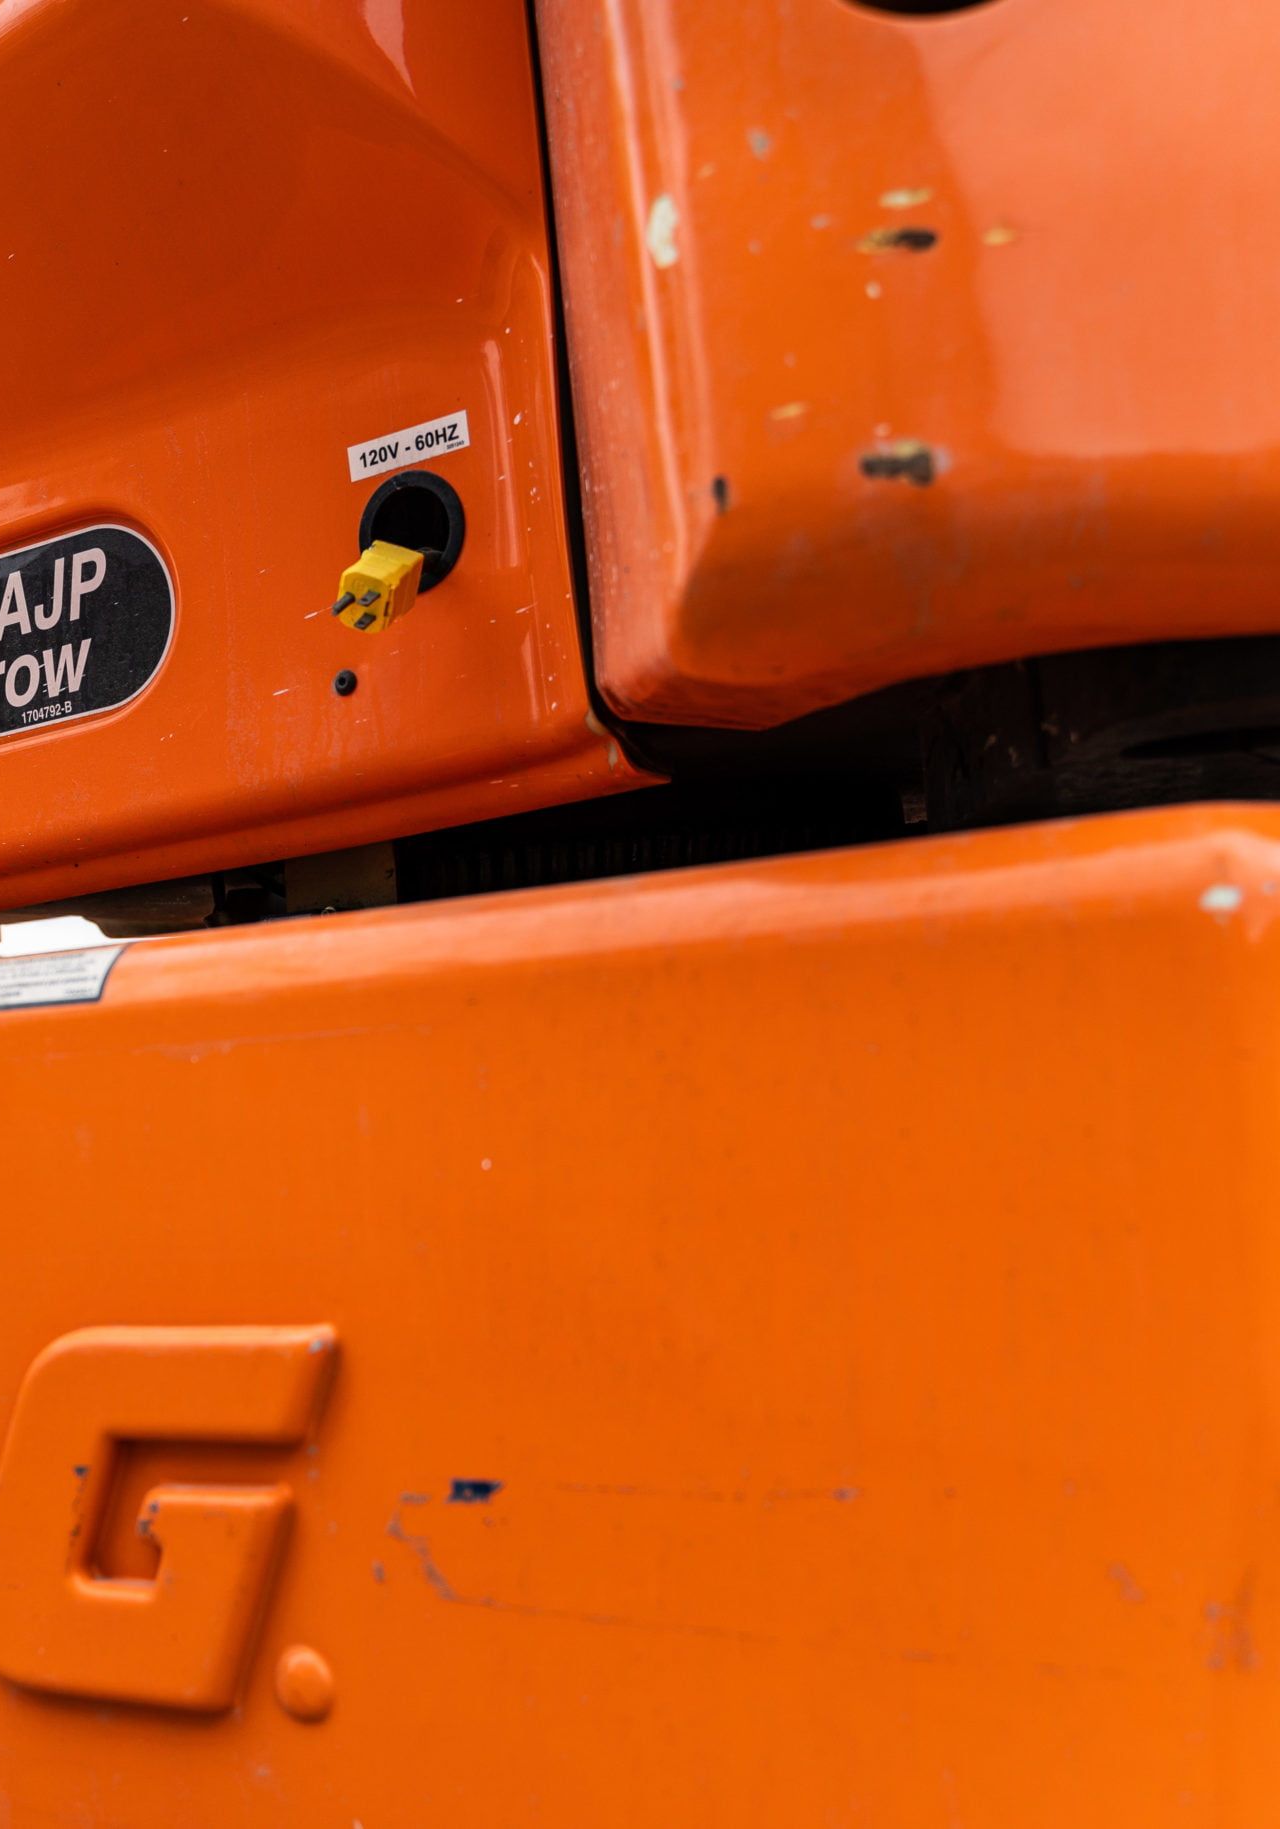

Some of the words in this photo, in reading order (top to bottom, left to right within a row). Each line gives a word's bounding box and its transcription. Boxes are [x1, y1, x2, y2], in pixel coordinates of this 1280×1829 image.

[359, 442, 400, 468] 120V
[414, 423, 460, 451] 60HZ
[21, 701, 72, 724] 1704792-B
